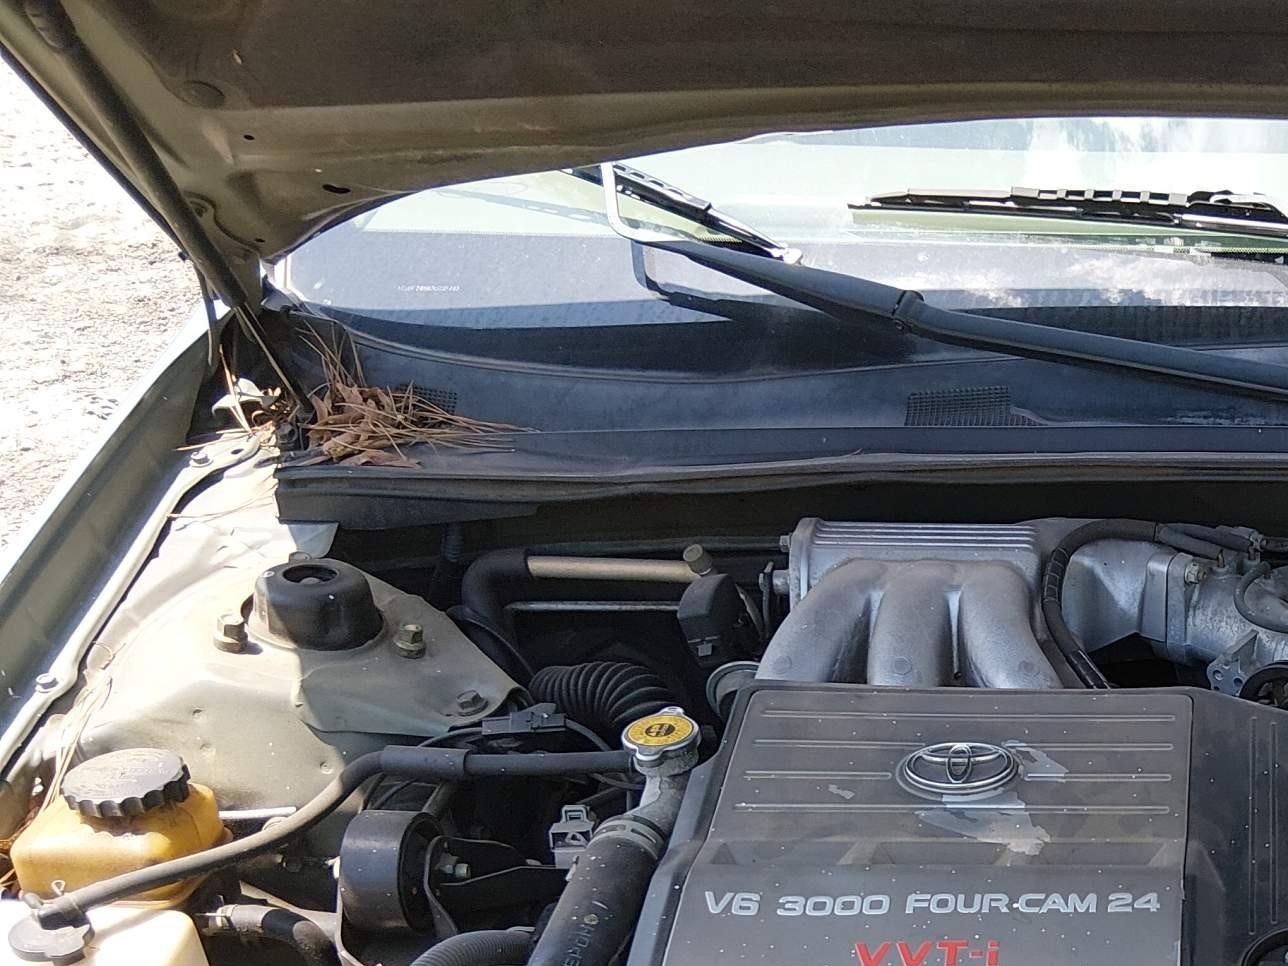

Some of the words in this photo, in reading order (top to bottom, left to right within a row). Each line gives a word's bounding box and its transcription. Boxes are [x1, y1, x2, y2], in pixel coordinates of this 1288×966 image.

[704, 890, 761, 916] V6
[776, 894, 891, 916] 3000
[1107, 892, 1161, 913] 24
